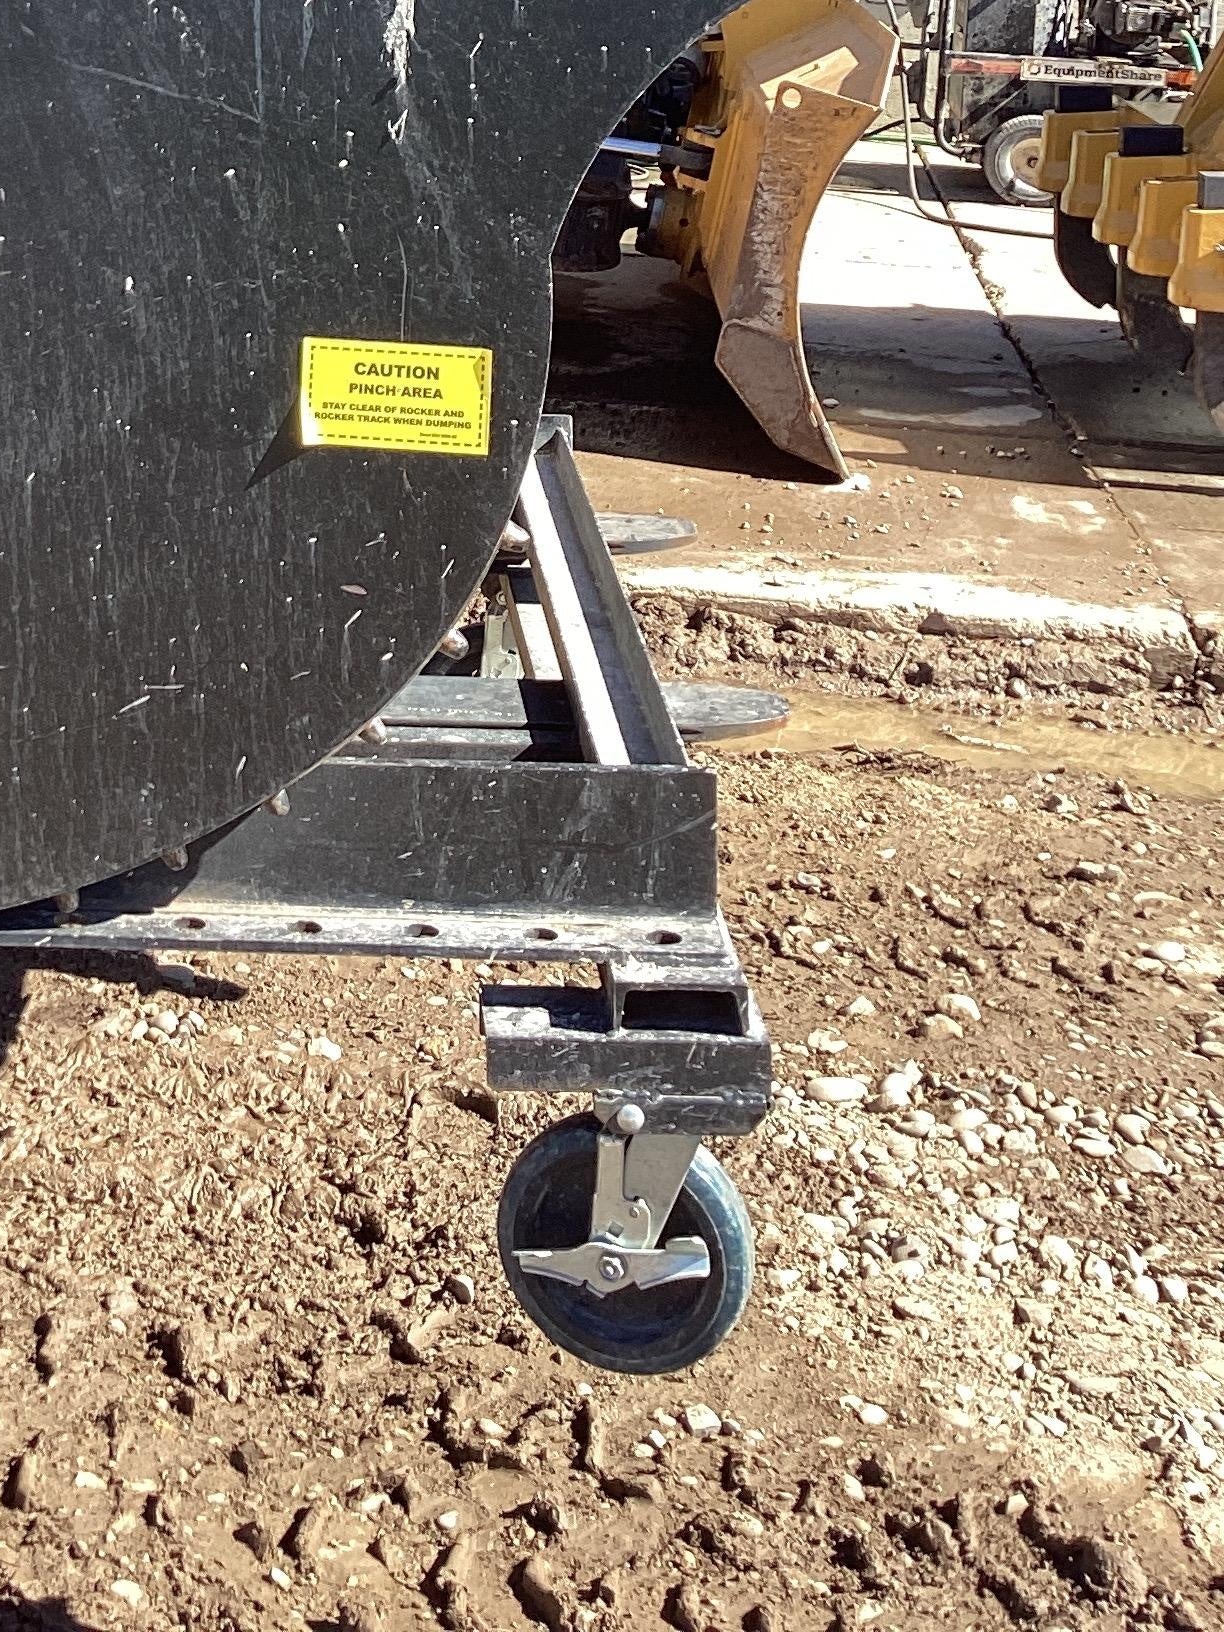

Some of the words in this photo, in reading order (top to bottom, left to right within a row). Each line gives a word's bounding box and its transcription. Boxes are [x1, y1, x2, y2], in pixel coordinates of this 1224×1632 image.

[1044, 64, 1162, 81] EquipmentShare
[354, 362, 440, 380] CAUTION
[349, 382, 396, 397] PINCH
[401, 386, 443, 399] AREA
[322, 401, 347, 410] STAY
[349, 403, 381, 413] CLEAR
[384, 405, 398, 414] OF
[400, 406, 440, 417] ROCKER
[443, 409, 464, 418] AND
[314, 412, 355, 422] ROCKER
[357, 414, 390, 424] TRACK
[393, 417, 423, 426] WHEN
[425, 419, 472, 429] DUMPING
